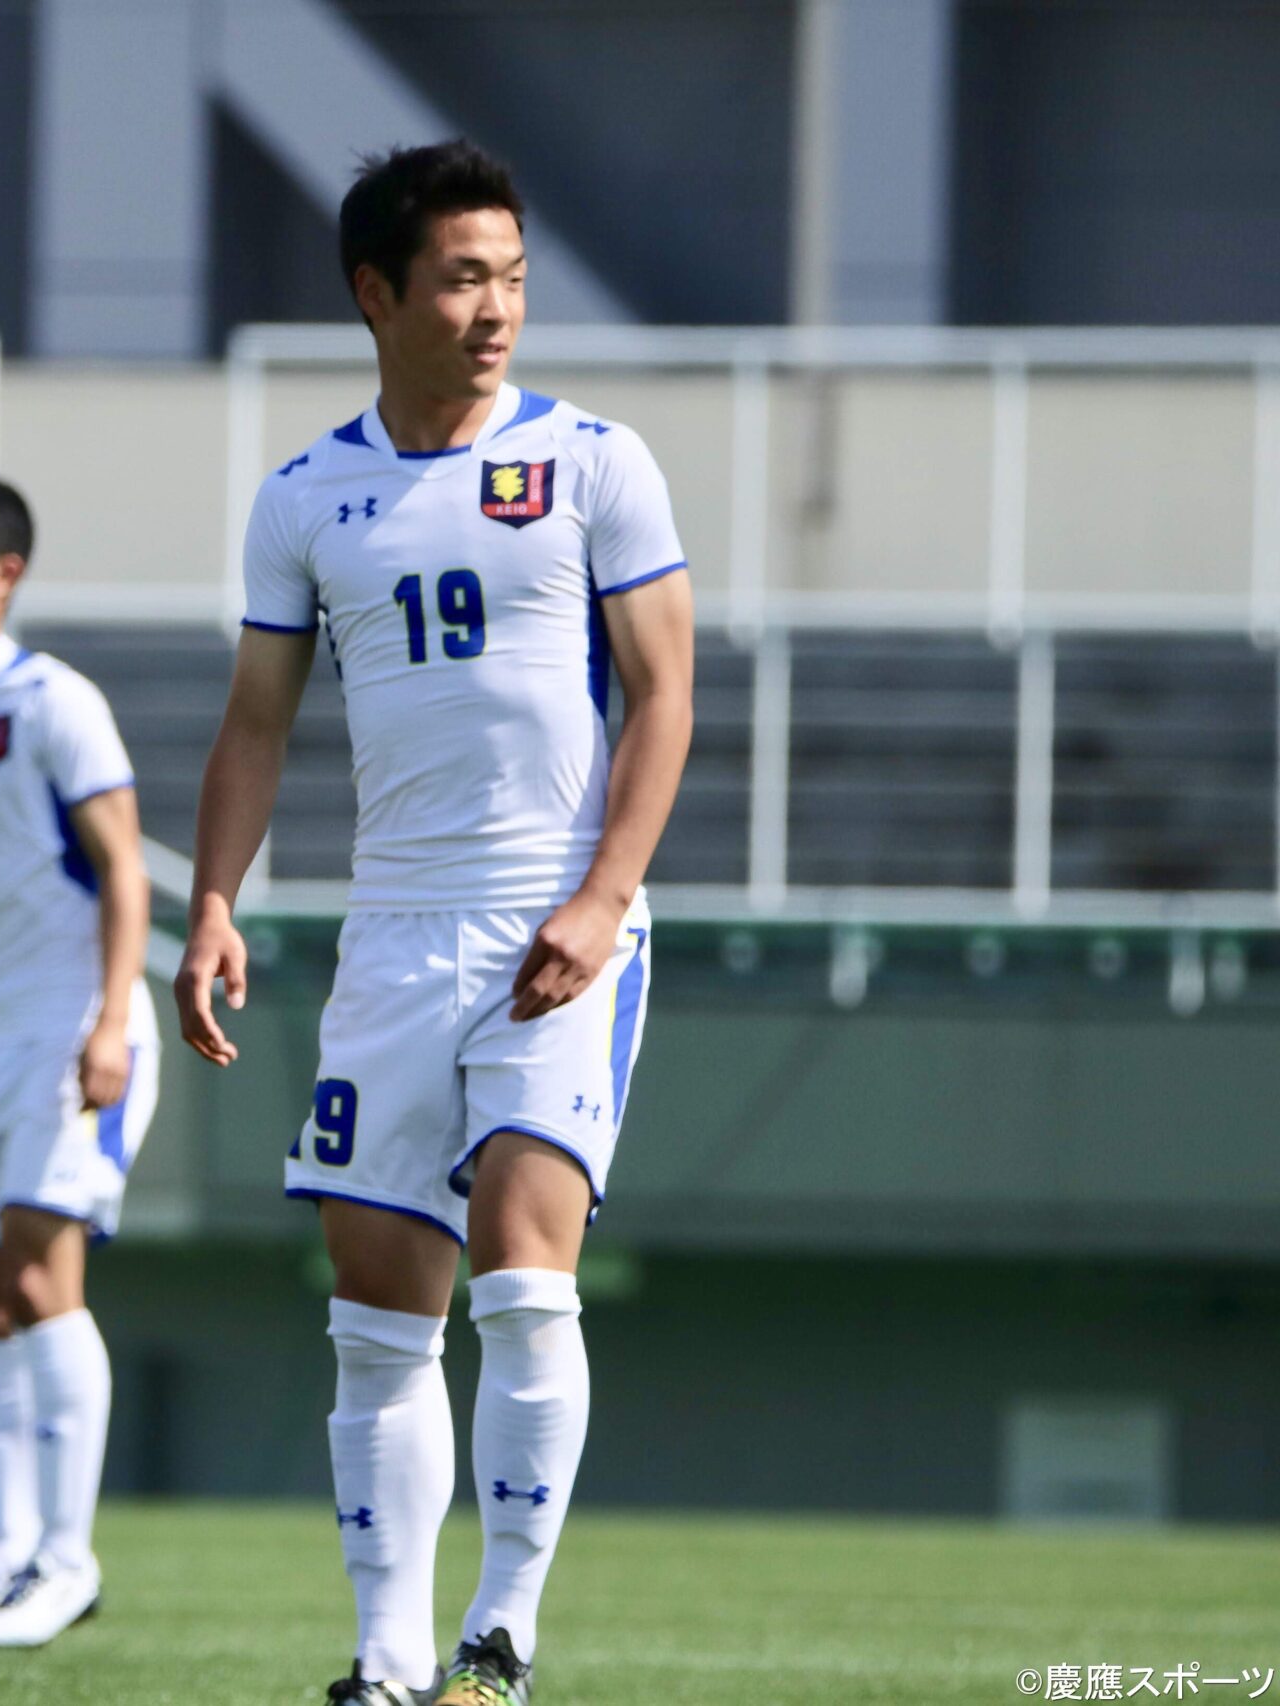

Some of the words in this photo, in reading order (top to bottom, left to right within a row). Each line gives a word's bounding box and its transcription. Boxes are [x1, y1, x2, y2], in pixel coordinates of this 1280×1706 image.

[496, 502, 528, 516] KEIO
[392, 567, 487, 665] 19
[287, 1077, 359, 1169] 9
